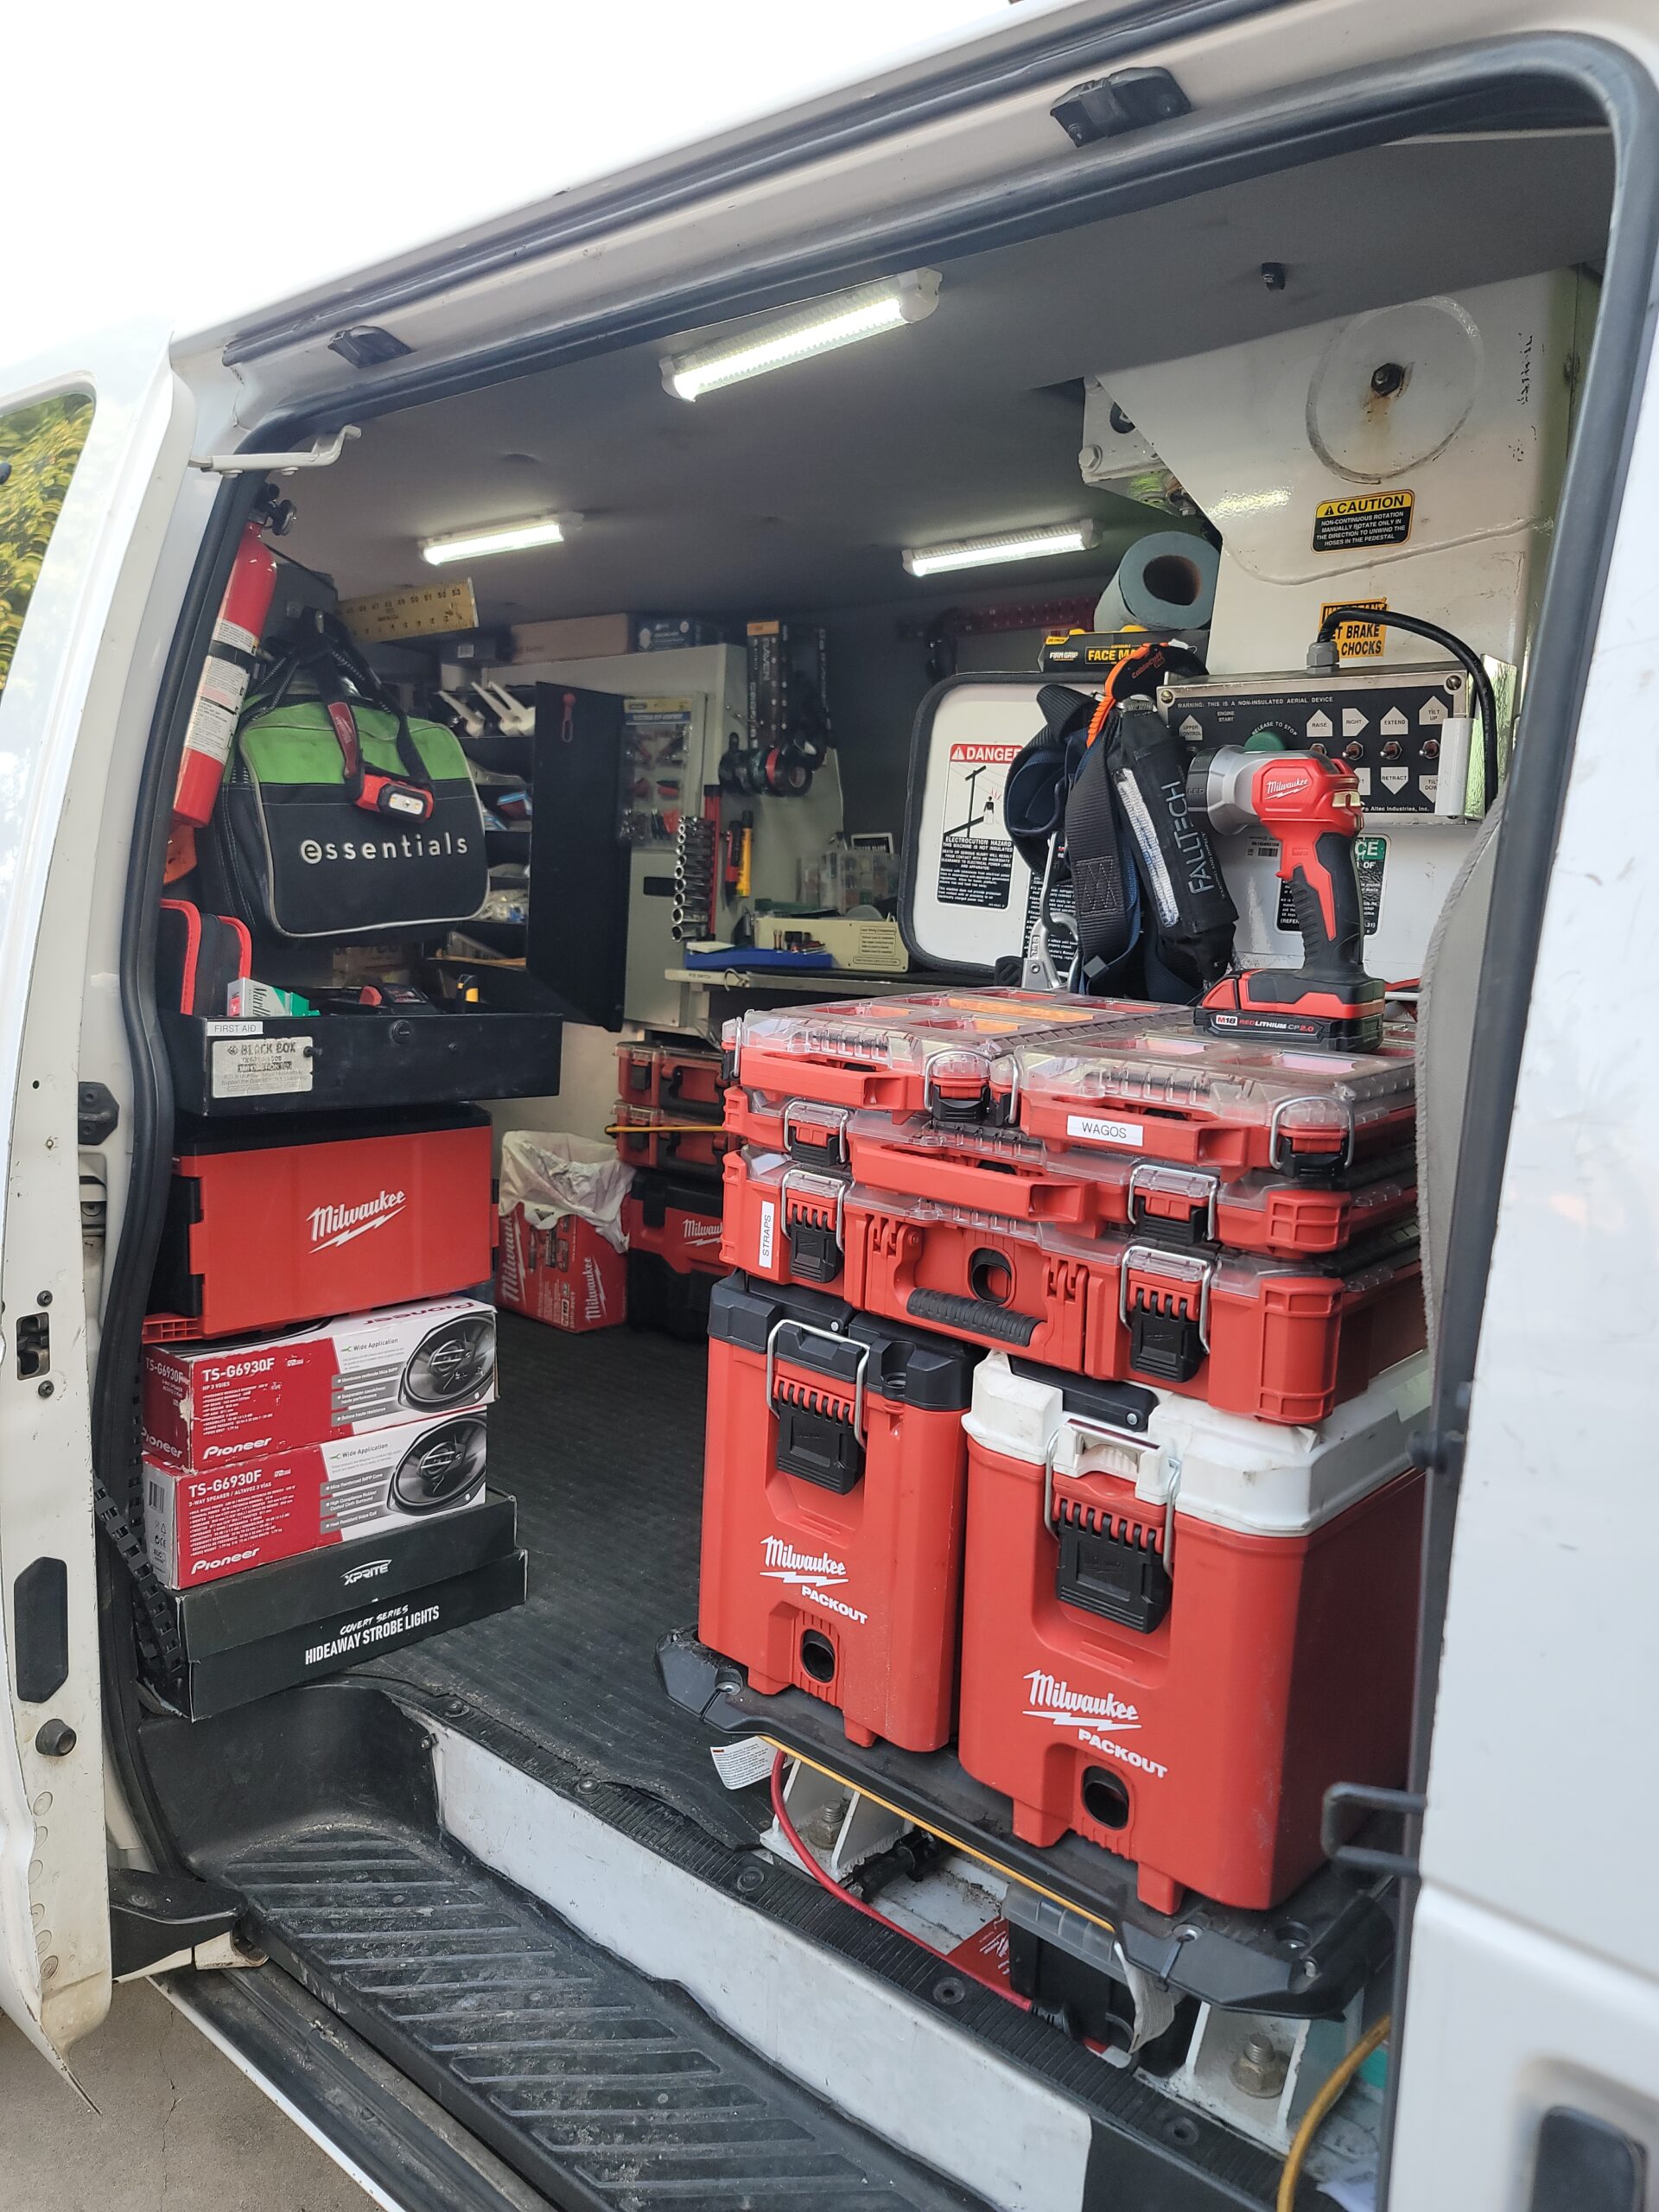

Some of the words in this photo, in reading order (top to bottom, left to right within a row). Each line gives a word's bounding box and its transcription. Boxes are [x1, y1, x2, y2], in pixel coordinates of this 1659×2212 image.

[1338, 495, 1404, 513] CAUTION
[1321, 515, 1372, 525] NON-CONTINUOUS
[1346, 624, 1380, 639] BRAKE
[1088, 650, 1116, 661] FACE
[1342, 640, 1382, 656] CHOCKS
[1252, 721, 1274, 735] RELEASE
[1283, 724, 1297, 735] STOP
[1266, 778, 1308, 794] Milwaukee
[301, 832, 467, 864] essentials
[945, 836, 988, 845] ELECTROCUTION
[1161, 781, 1214, 894] FALLTECH
[1082, 1122, 1127, 1138] WAGOS
[306, 1191, 406, 1242] Milwaukee
[582, 1256, 601, 1324] Milwaukee
[364, 1302, 474, 1325] Pioneer
[368, 1338, 398, 1349] Application
[202, 1357, 276, 1382] TS-G6930F
[203, 1437, 272, 1459] Pioneer
[357, 1443, 388, 1454] Application
[188, 1469, 262, 1497] TS-G6930F
[188, 1498, 206, 1507] 3-WAY
[207, 1492, 230, 1503] SPEAKER
[235, 1485, 256, 1495] ALTAVOZ
[190, 1548, 260, 1574] Pioneer
[760, 1535, 847, 1576] Milwaukee
[344, 1562, 389, 1586] XPRITE
[802, 1585, 868, 1624] PACKOUT
[340, 1617, 374, 1636] COVERT
[376, 1605, 409, 1623] SERIES
[305, 1633, 361, 1665] HIDEAWAY
[363, 1618, 404, 1644] STROBE
[405, 1605, 440, 1630] LIGHTS
[1023, 1669, 1139, 1720] Milwaukee
[1078, 1728, 1168, 1778] PACKOUT
